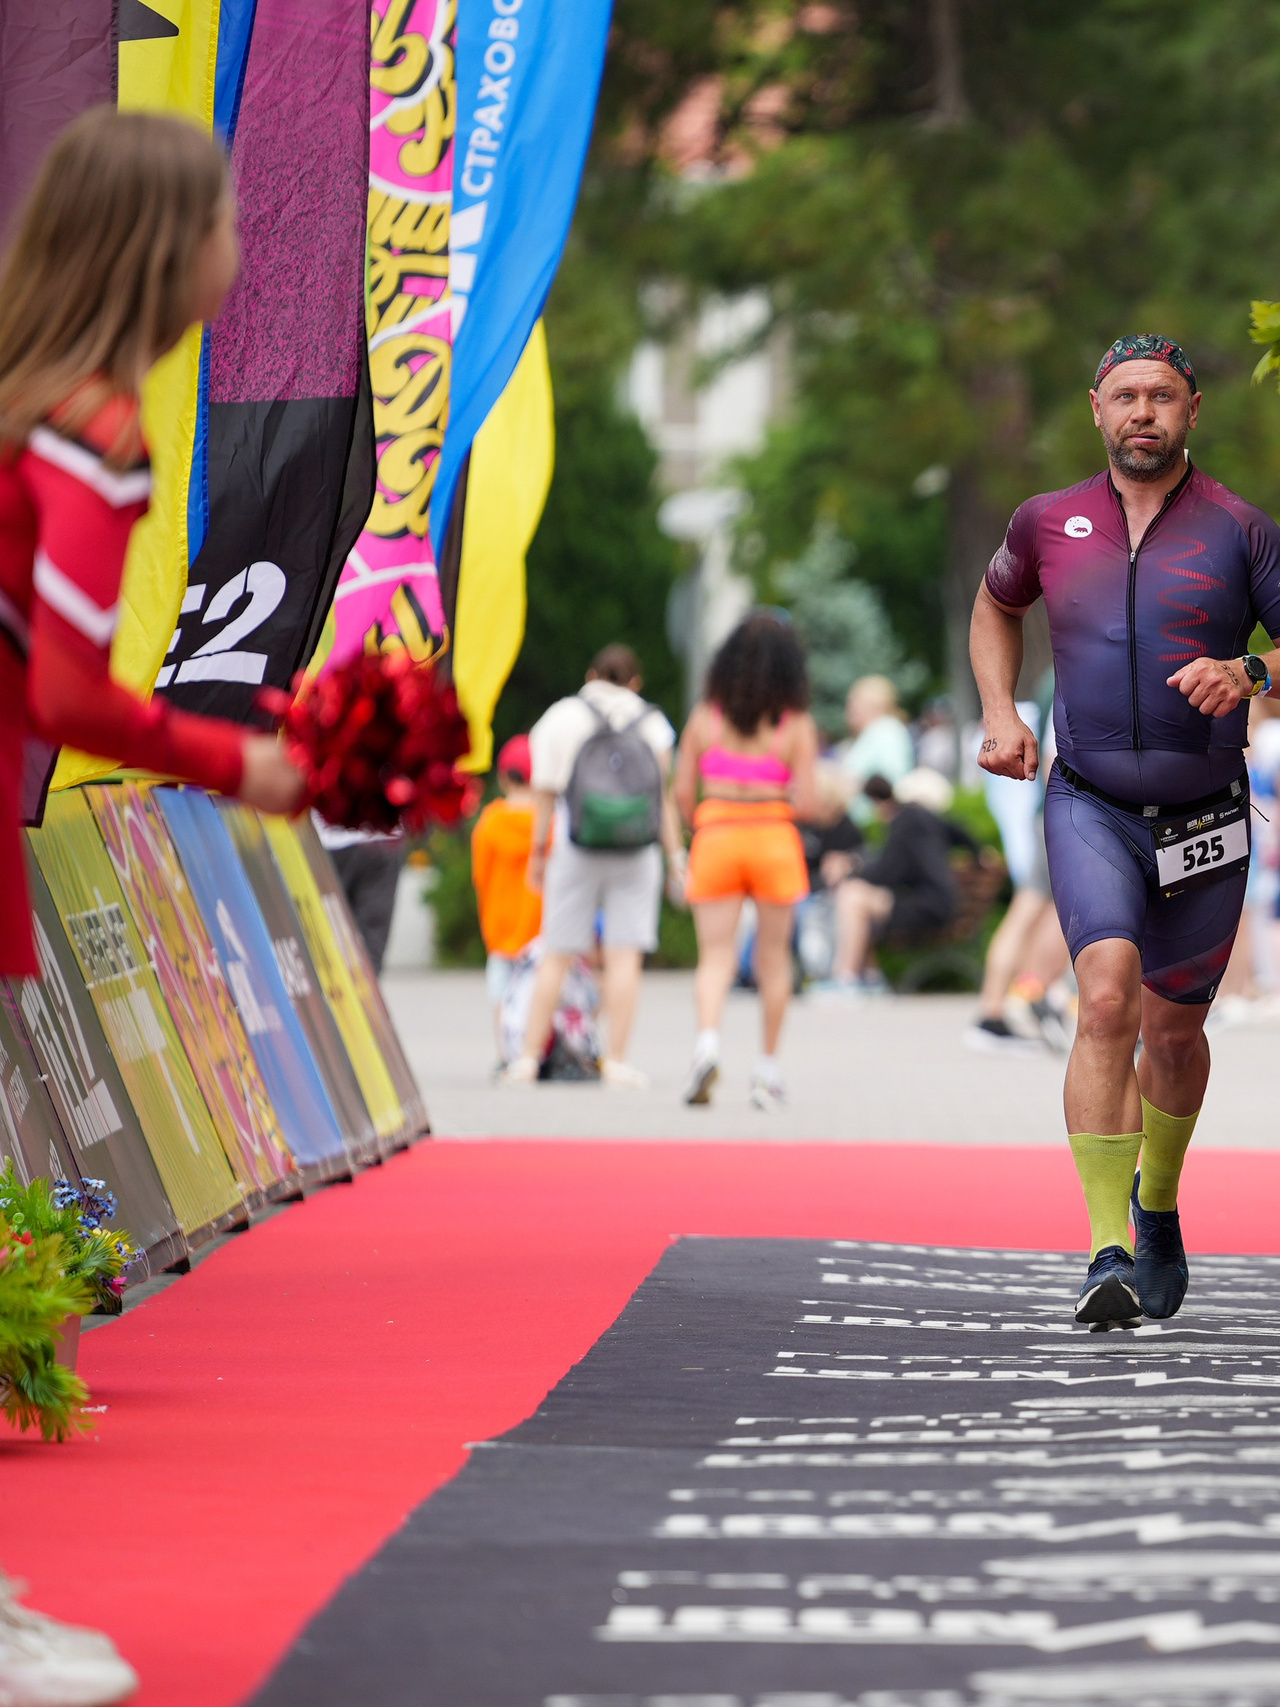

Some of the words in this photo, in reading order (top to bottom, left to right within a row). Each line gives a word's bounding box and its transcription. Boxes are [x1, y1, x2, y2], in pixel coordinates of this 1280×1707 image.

[982, 738, 998, 753] 525
[1201, 813, 1215, 823] STAR
[1183, 835, 1225, 872] 525
[802, 1314, 1073, 1331] IRON
